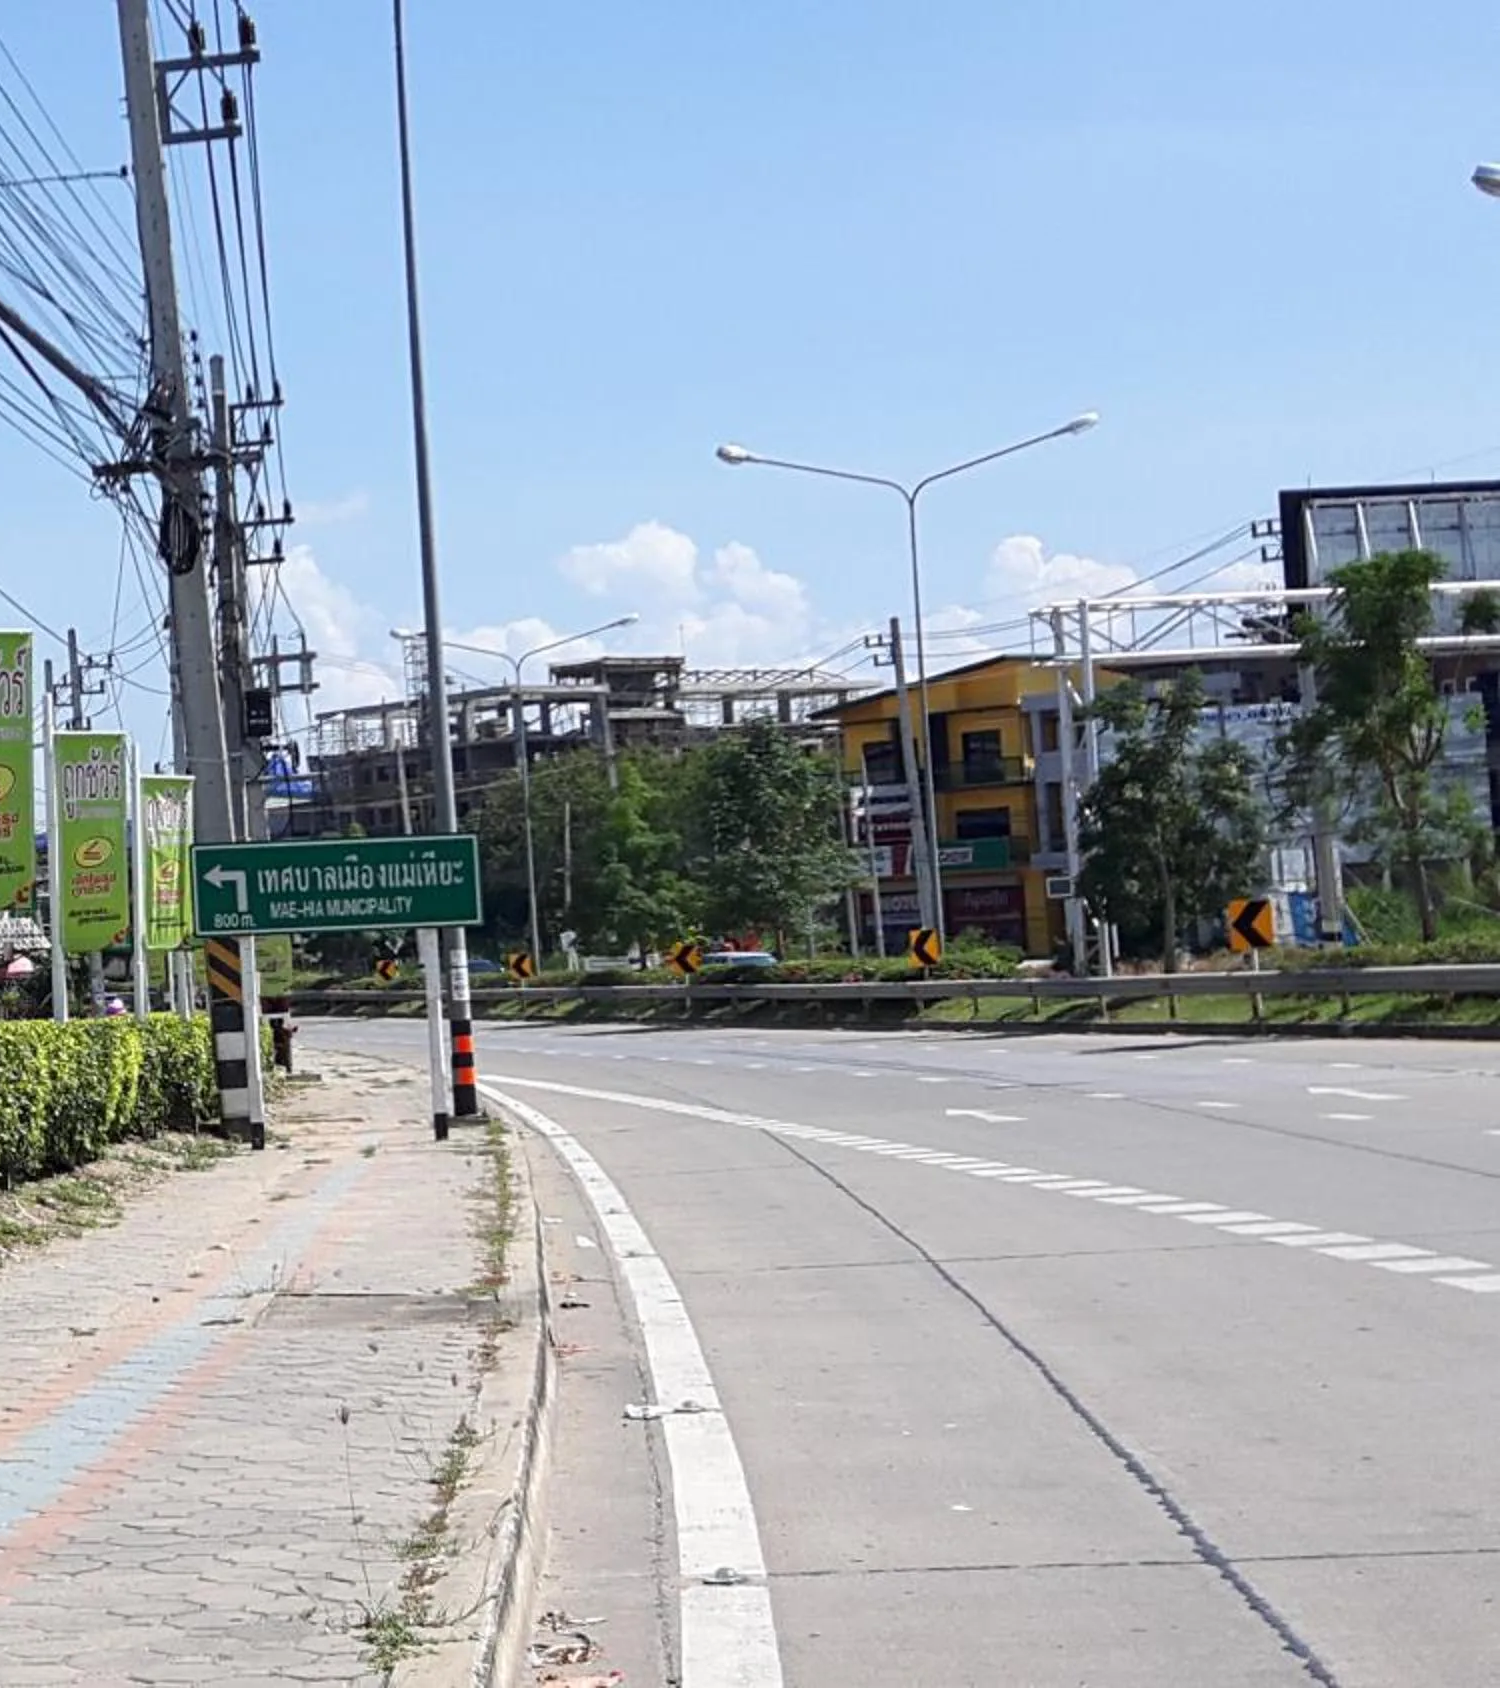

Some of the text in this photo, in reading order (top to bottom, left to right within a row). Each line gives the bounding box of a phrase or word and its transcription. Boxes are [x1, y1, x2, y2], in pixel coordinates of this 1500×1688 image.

[269, 896, 413, 919] MAE-HIA MUNICIPALITY
[214, 913, 239, 928] 800
